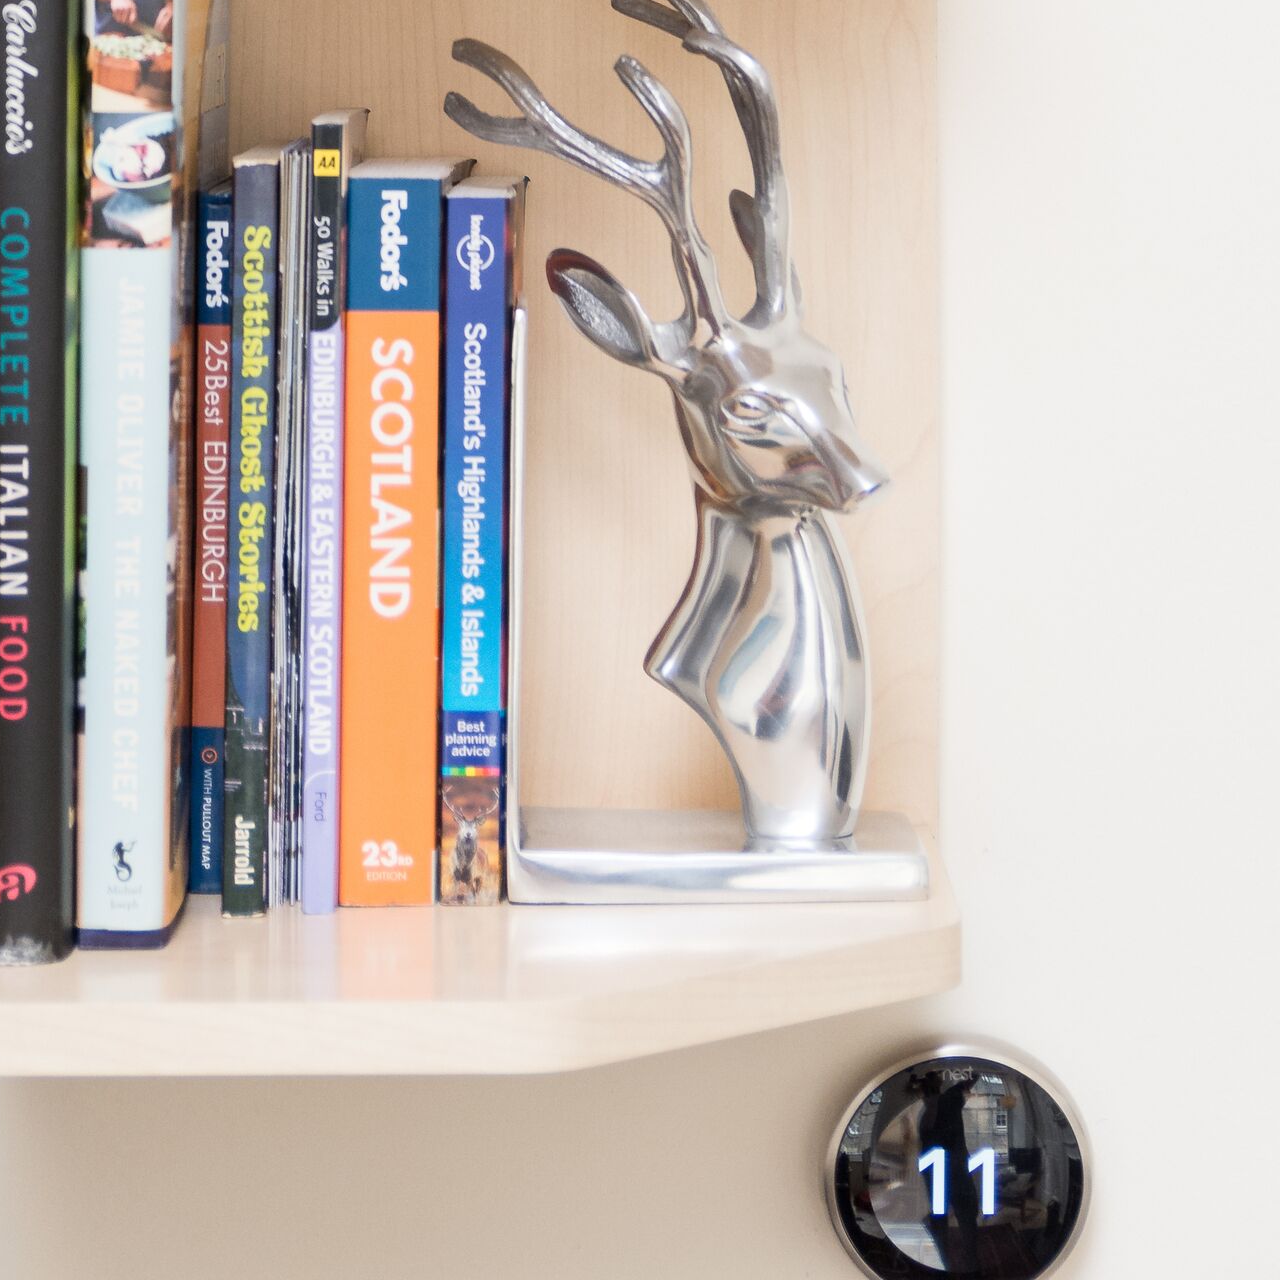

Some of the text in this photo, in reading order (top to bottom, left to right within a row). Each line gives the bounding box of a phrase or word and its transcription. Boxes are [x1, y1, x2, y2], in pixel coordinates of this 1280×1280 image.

[1, 0, 38, 155] Carluccio's
[318, 156, 336, 168] AA
[205, 219, 230, 308] Fodor's
[379, 189, 408, 292] Fodor's
[466, 214, 483, 291] lonely planet
[0, 206, 30, 426] COMPLETE
[237, 225, 272, 633] Scottish Ghost Stories
[201, 441, 227, 602] EDINBURGH
[308, 216, 336, 756] 50 Walks in EDINBURGH & EASTERN SCOTLAND
[368, 337, 413, 619] SCOTLAND
[457, 322, 487, 697] Scotland's Highlands & Islands
[112, 277, 146, 813] JAMIE OLIVER THE NAKED CHEF
[445, 733, 497, 747] planning
[451, 745, 491, 757] advice
[457, 720, 485, 732] Best
[201, 768, 213, 870] WITH PULLOUT MAP
[234, 815, 256, 885] Jarrold
[313, 791, 328, 822] Ford
[366, 871, 407, 881] EDITION
[941, 1066, 974, 1082] nest
[918, 1146, 996, 1216] 11
